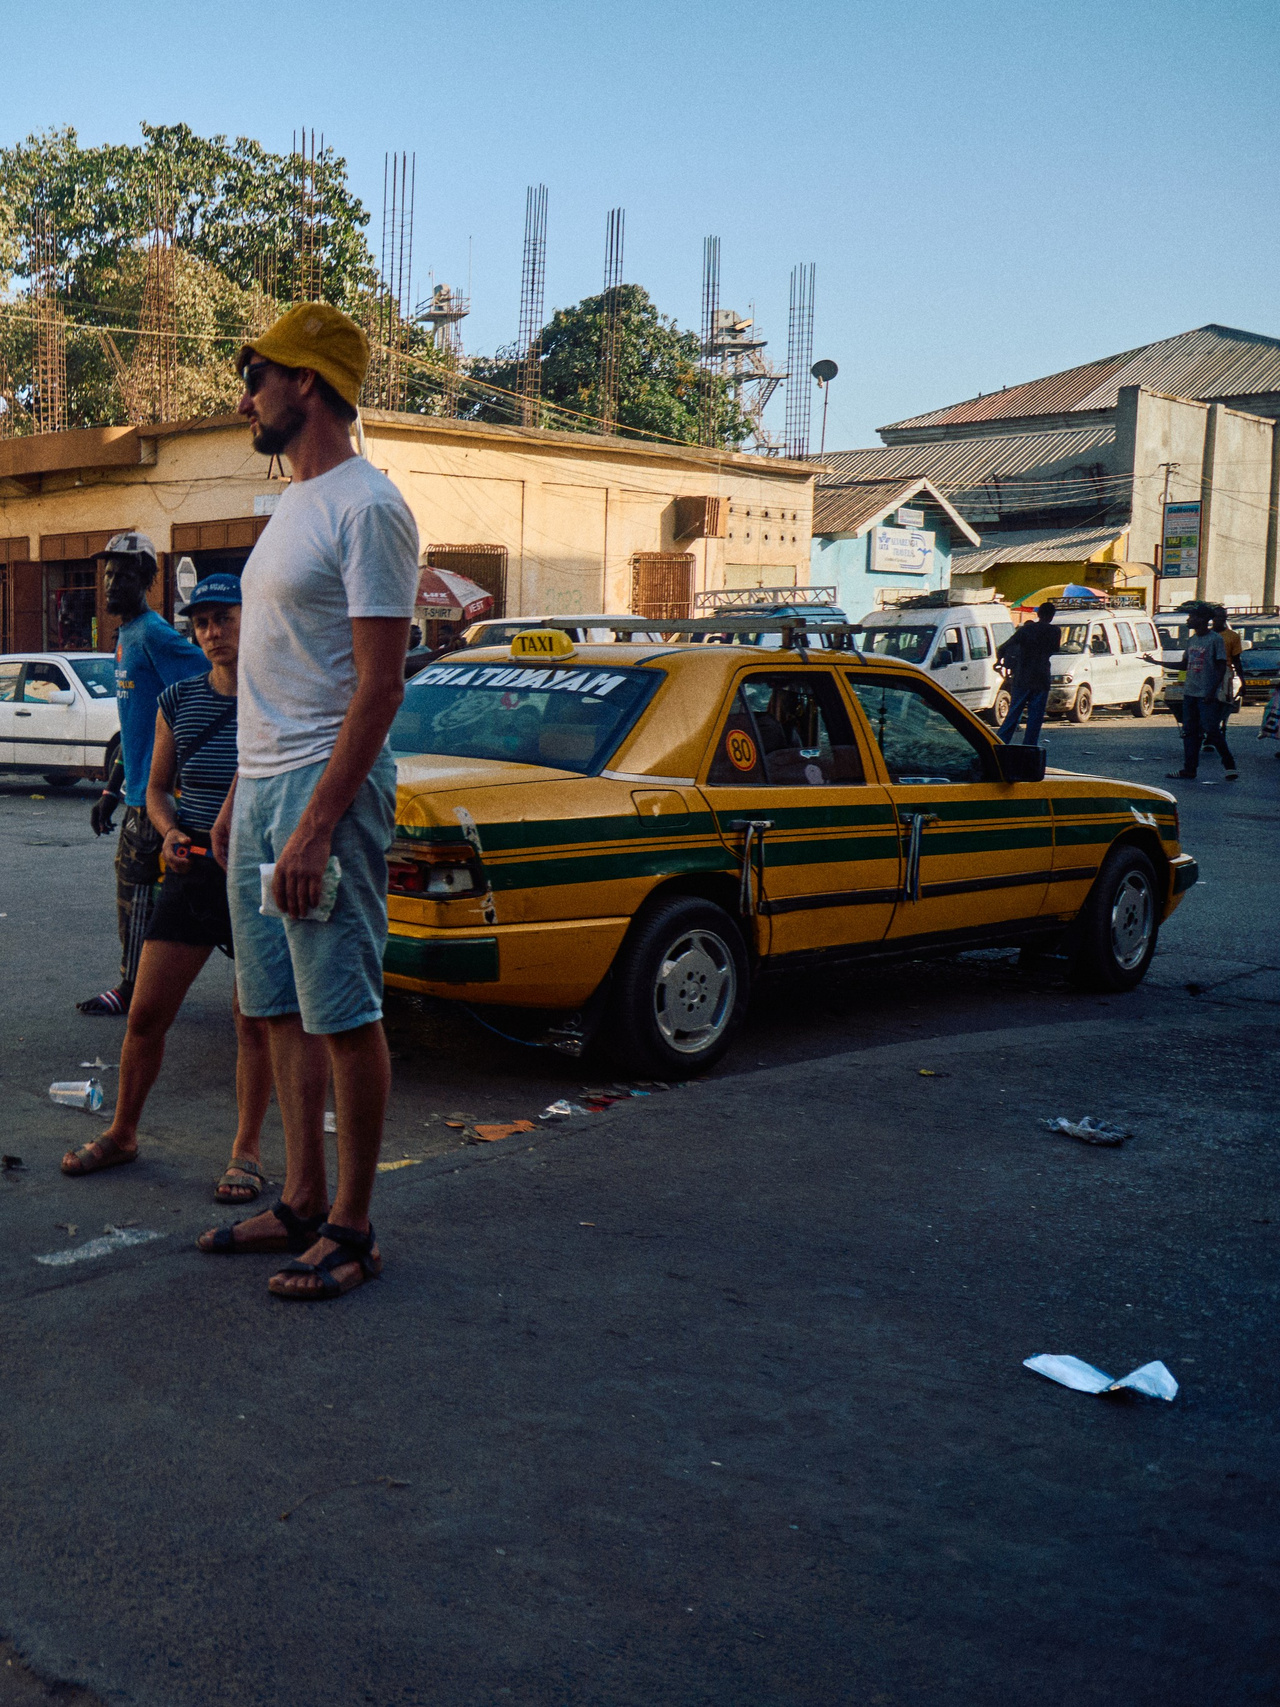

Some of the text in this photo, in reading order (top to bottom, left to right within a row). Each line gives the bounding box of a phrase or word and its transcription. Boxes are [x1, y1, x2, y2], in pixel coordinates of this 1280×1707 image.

[423, 607, 452, 617] T-SHIRT
[517, 636, 554, 652] TAXI
[731, 738, 751, 762] 80
